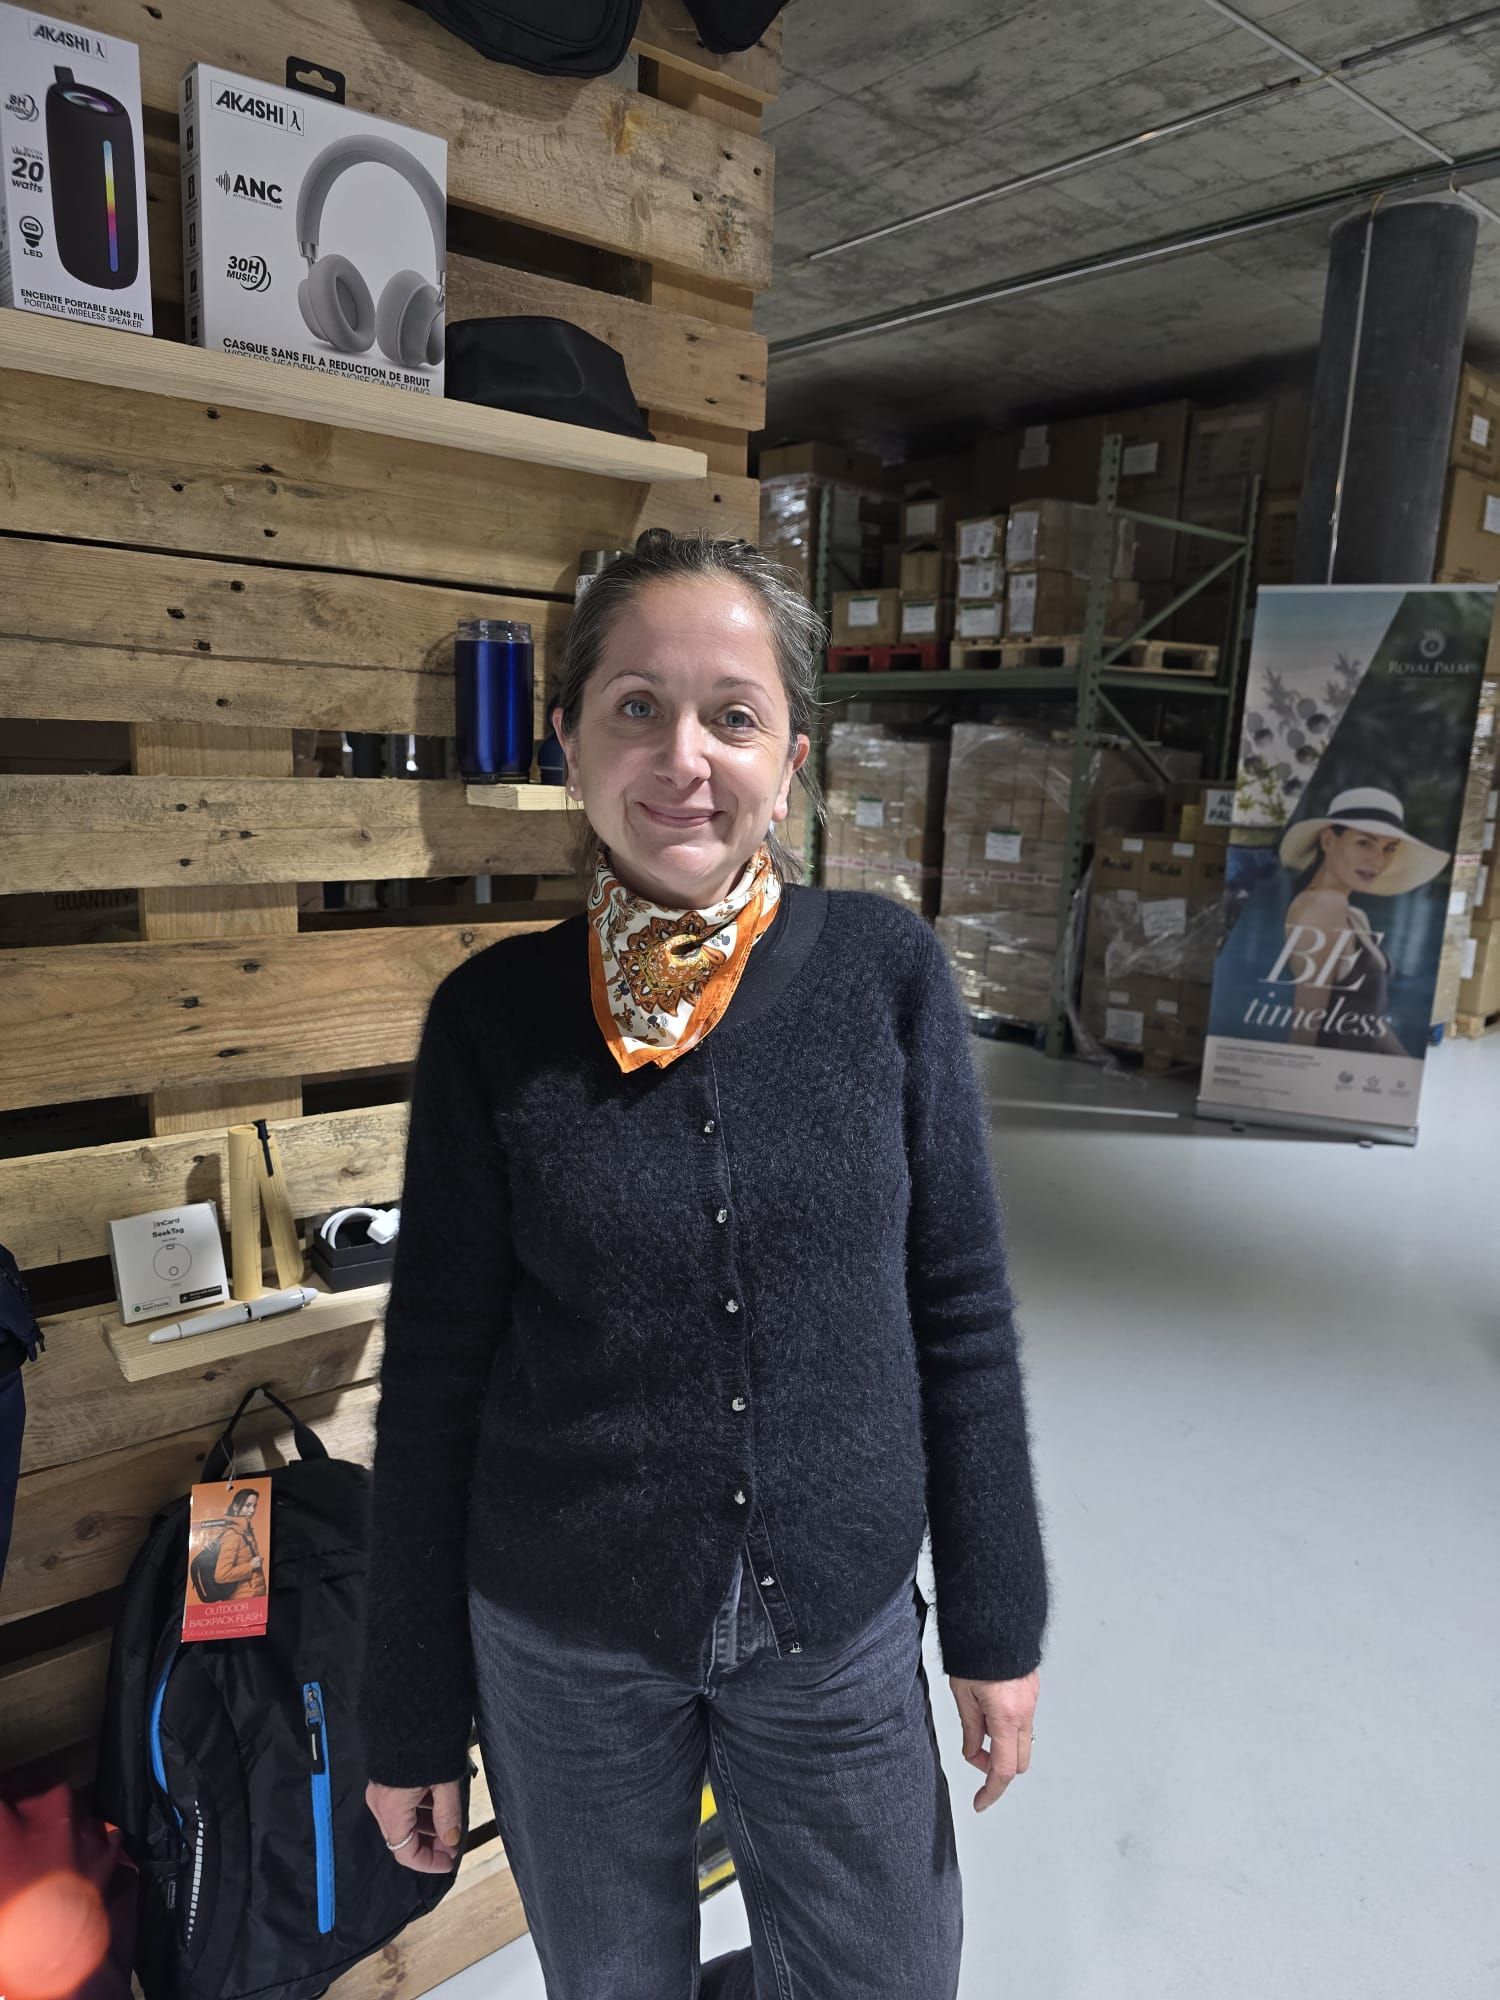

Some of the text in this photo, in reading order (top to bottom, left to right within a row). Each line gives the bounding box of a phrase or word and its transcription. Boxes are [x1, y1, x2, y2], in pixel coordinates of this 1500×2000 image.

[34, 24, 90, 54] AKASHI
[215, 89, 284, 125] AKASHI
[11, 157, 44, 182] 20
[11, 178, 43, 193] watts
[233, 174, 283, 204] ANC
[23, 248, 43, 258] LED
[227, 255, 260, 275] 30H
[226, 269, 258, 284] MUSIC
[20, 288, 145, 321] ENCEINTE PORTABLE SANS FIL
[24, 298, 142, 328] PORTABLE WIRELESS SPEAKER
[223, 337, 430, 388] CASQUE SANS FIL A REDUCTION DE BRUIT
[54, 891, 130, 911] QUANTITY
[1258, 924, 1385, 992] BE
[1243, 992, 1393, 1038] timeless
[189, 1612, 263, 1629] BACKPACK FLASH
[204, 1602, 249, 1616] OUTDOOR
